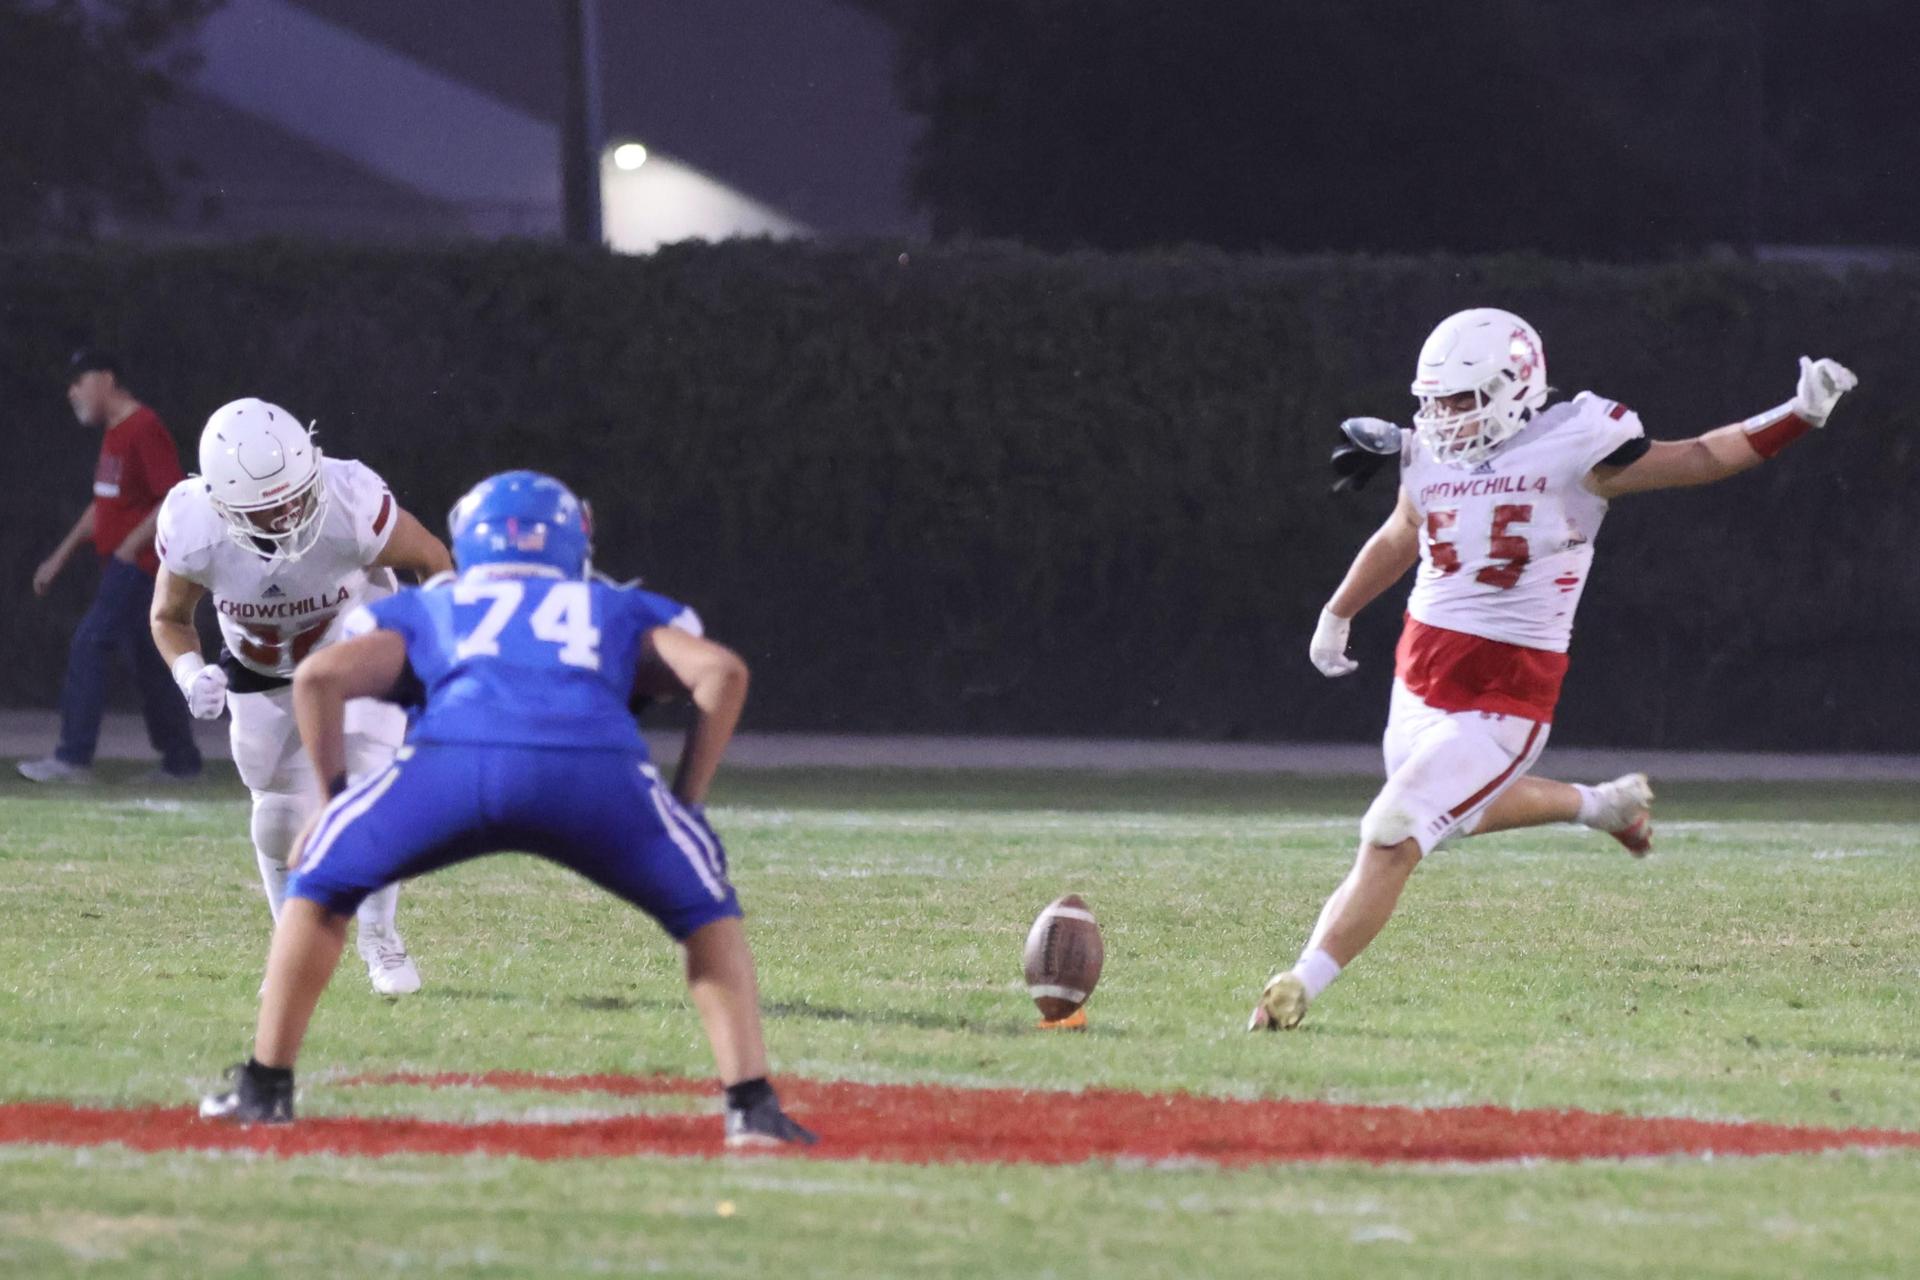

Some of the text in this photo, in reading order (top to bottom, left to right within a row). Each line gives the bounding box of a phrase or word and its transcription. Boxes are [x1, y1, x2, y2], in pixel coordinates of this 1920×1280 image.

[1427, 504, 1533, 590] 55
[219, 586, 350, 618] CHOWCHILLA
[453, 579, 600, 670] 74
